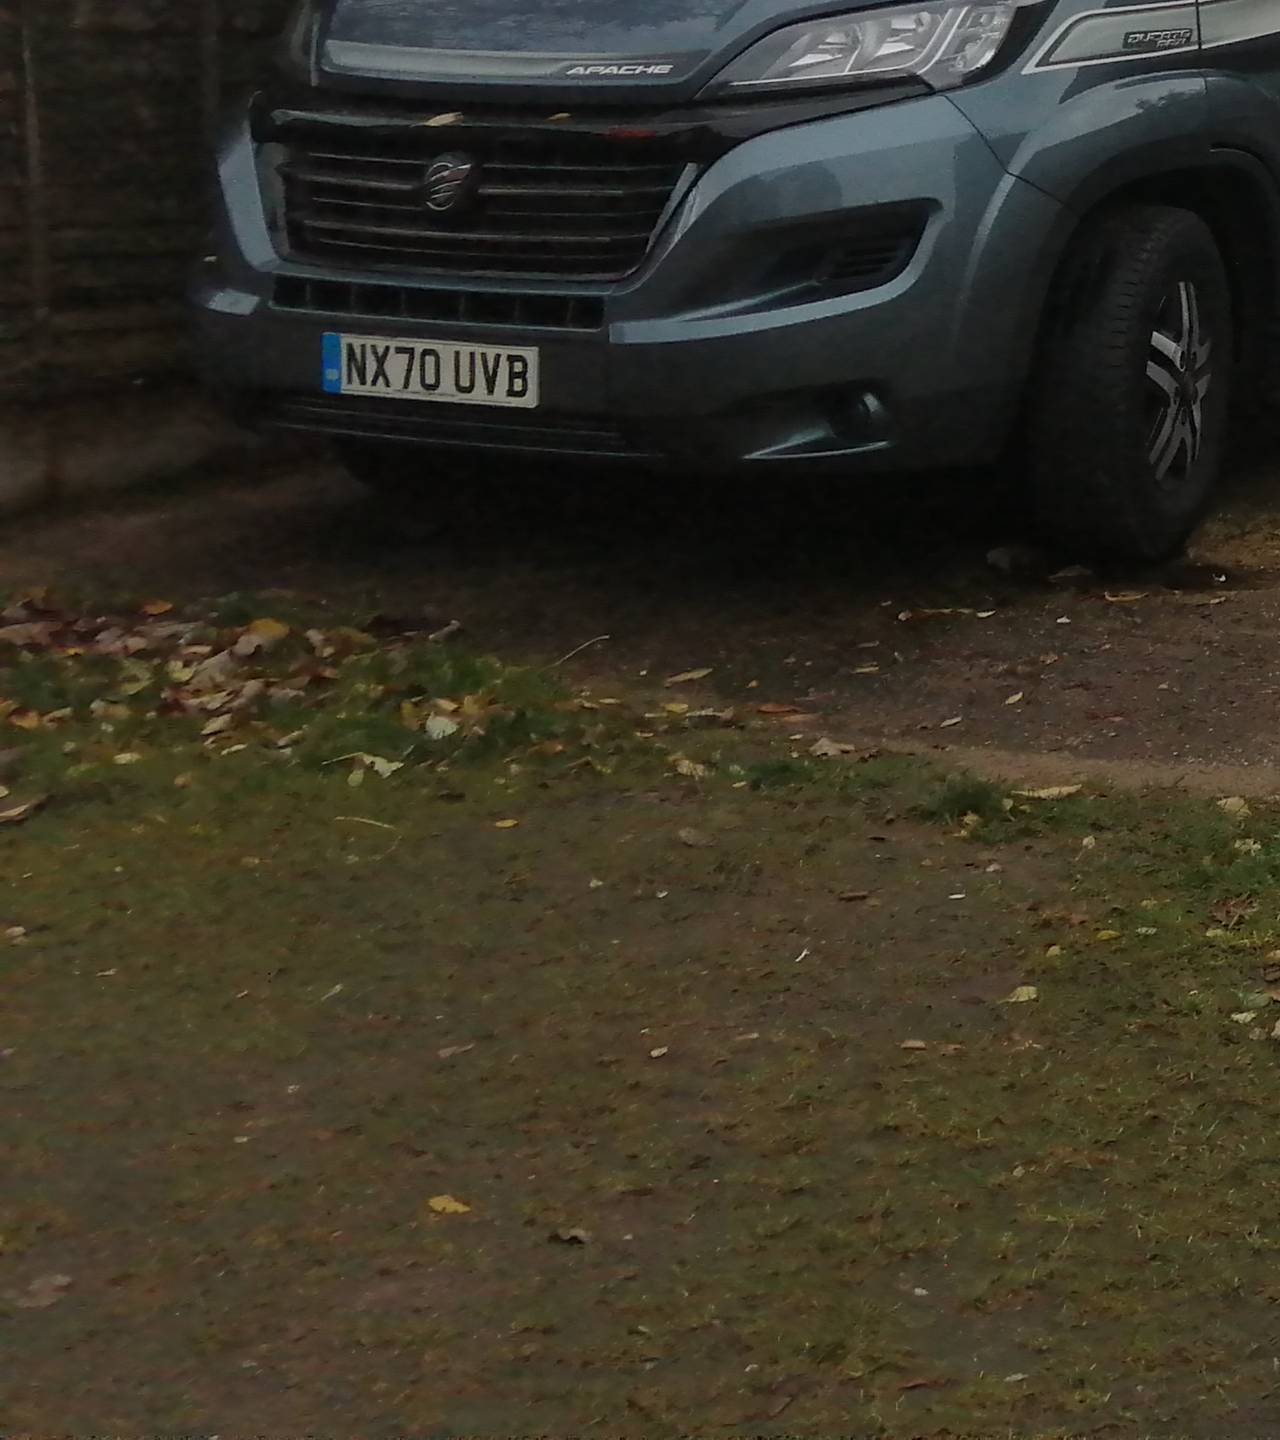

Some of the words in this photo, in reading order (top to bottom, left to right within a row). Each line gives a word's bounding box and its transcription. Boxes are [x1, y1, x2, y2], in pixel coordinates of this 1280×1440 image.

[566, 64, 674, 75] APACHE
[346, 342, 441, 392] NX70
[454, 350, 529, 398] UVB
